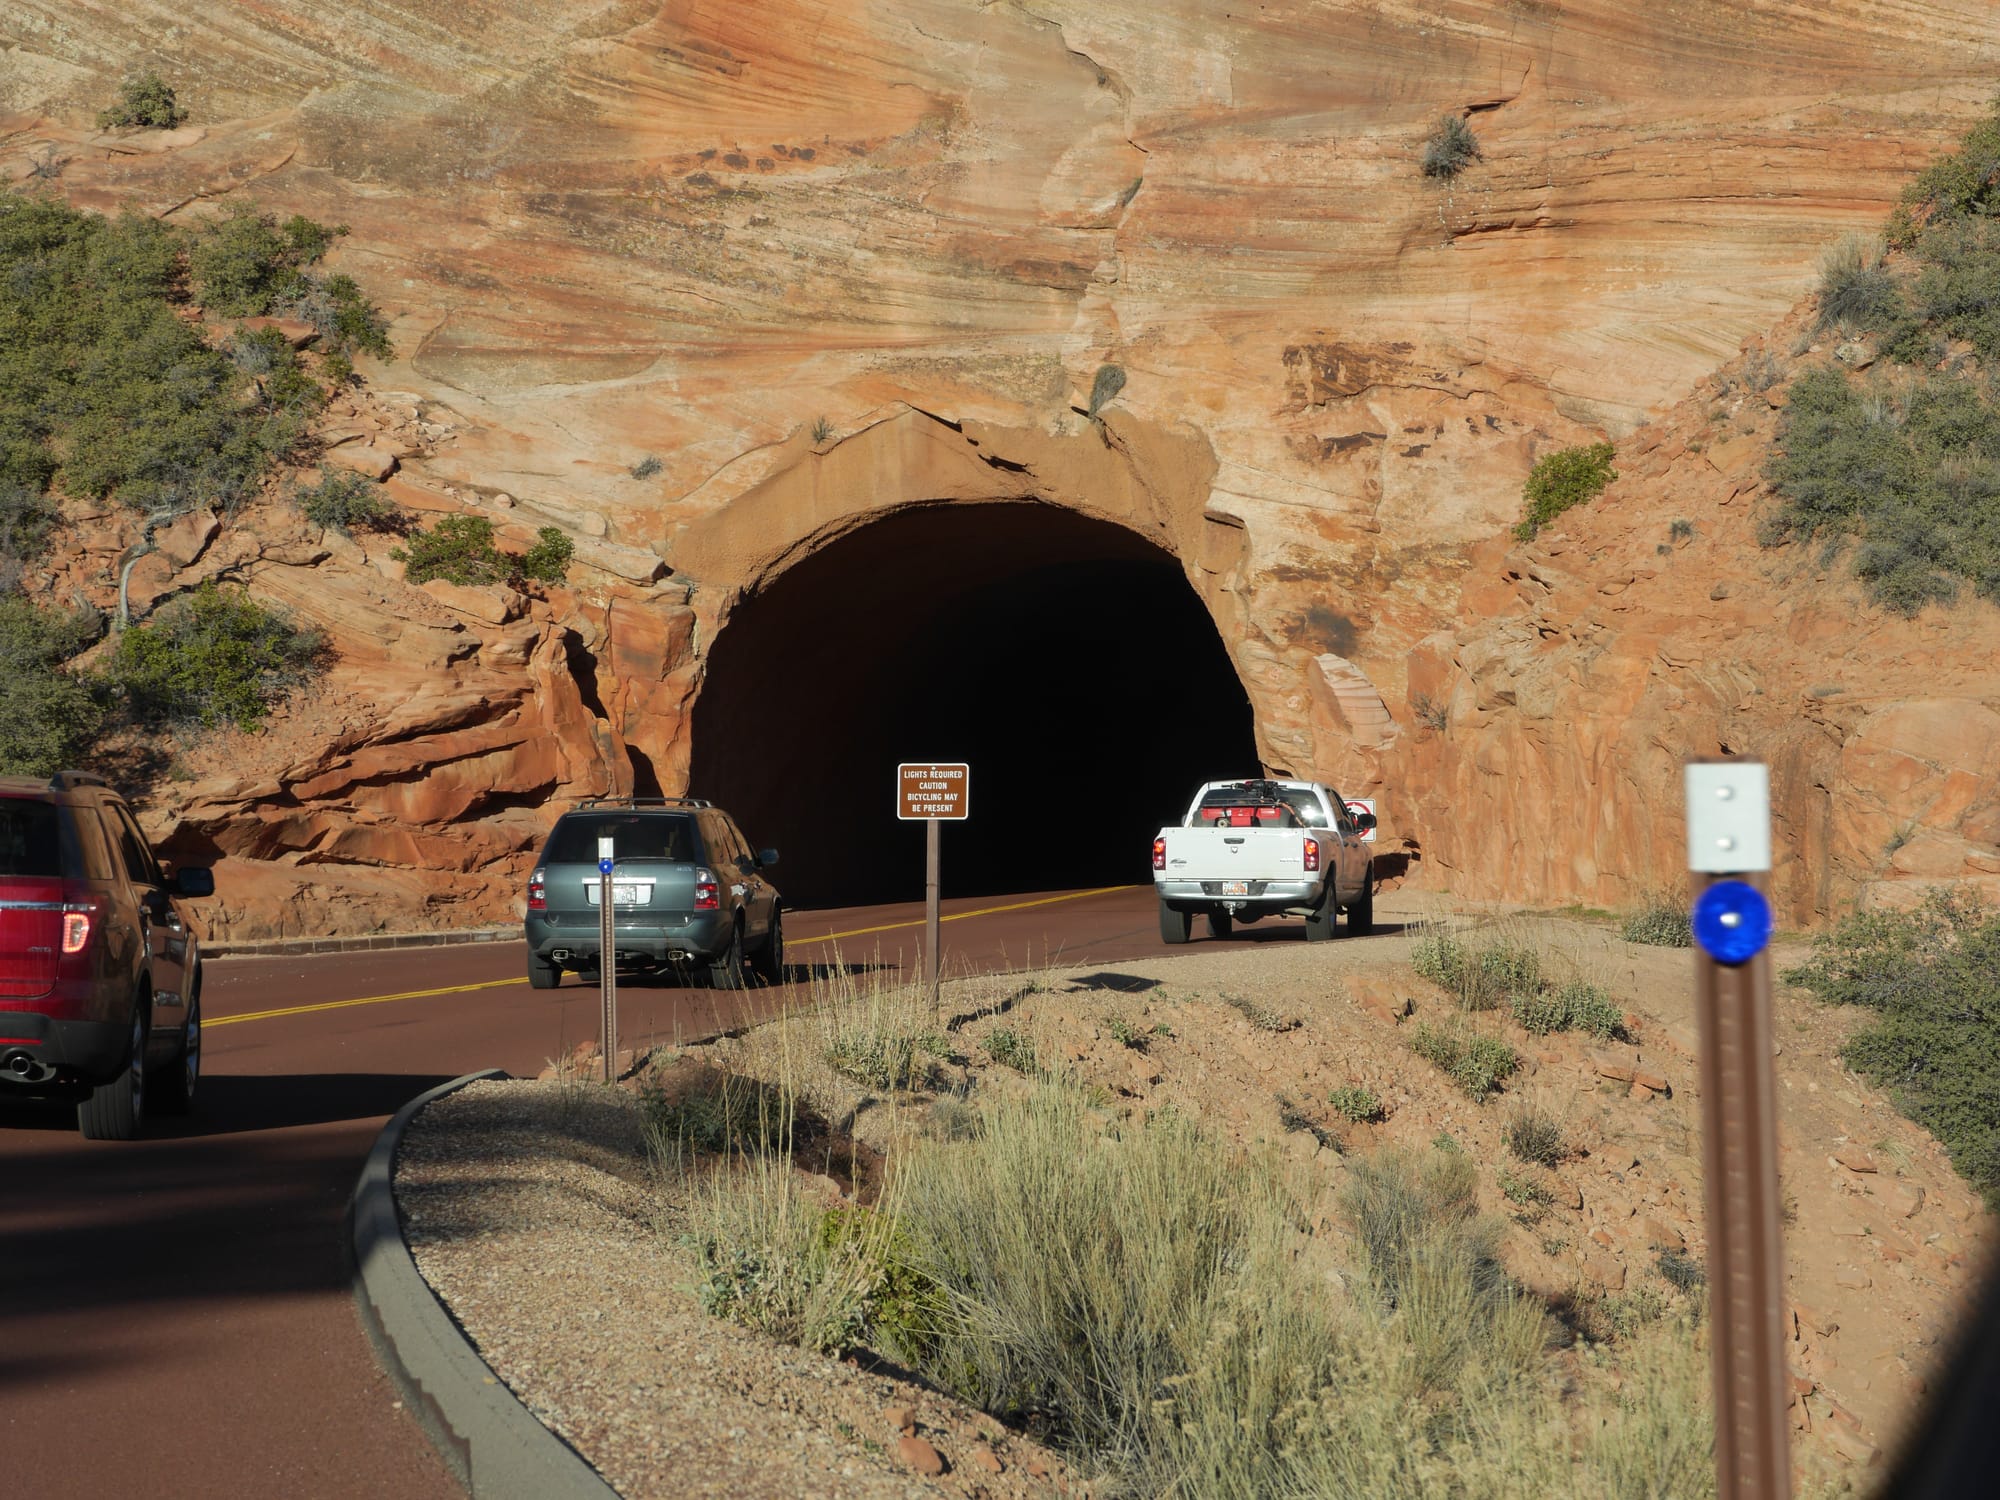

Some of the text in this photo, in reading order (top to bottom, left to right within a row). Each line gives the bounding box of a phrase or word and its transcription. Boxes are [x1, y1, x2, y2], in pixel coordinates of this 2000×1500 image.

[904, 770, 963, 779] LIGHTS REQUIRED
[919, 782, 947, 790] CAUTION
[907, 793, 958, 801] BICYCLING MAY
[912, 804, 953, 812] BE PRESENT
